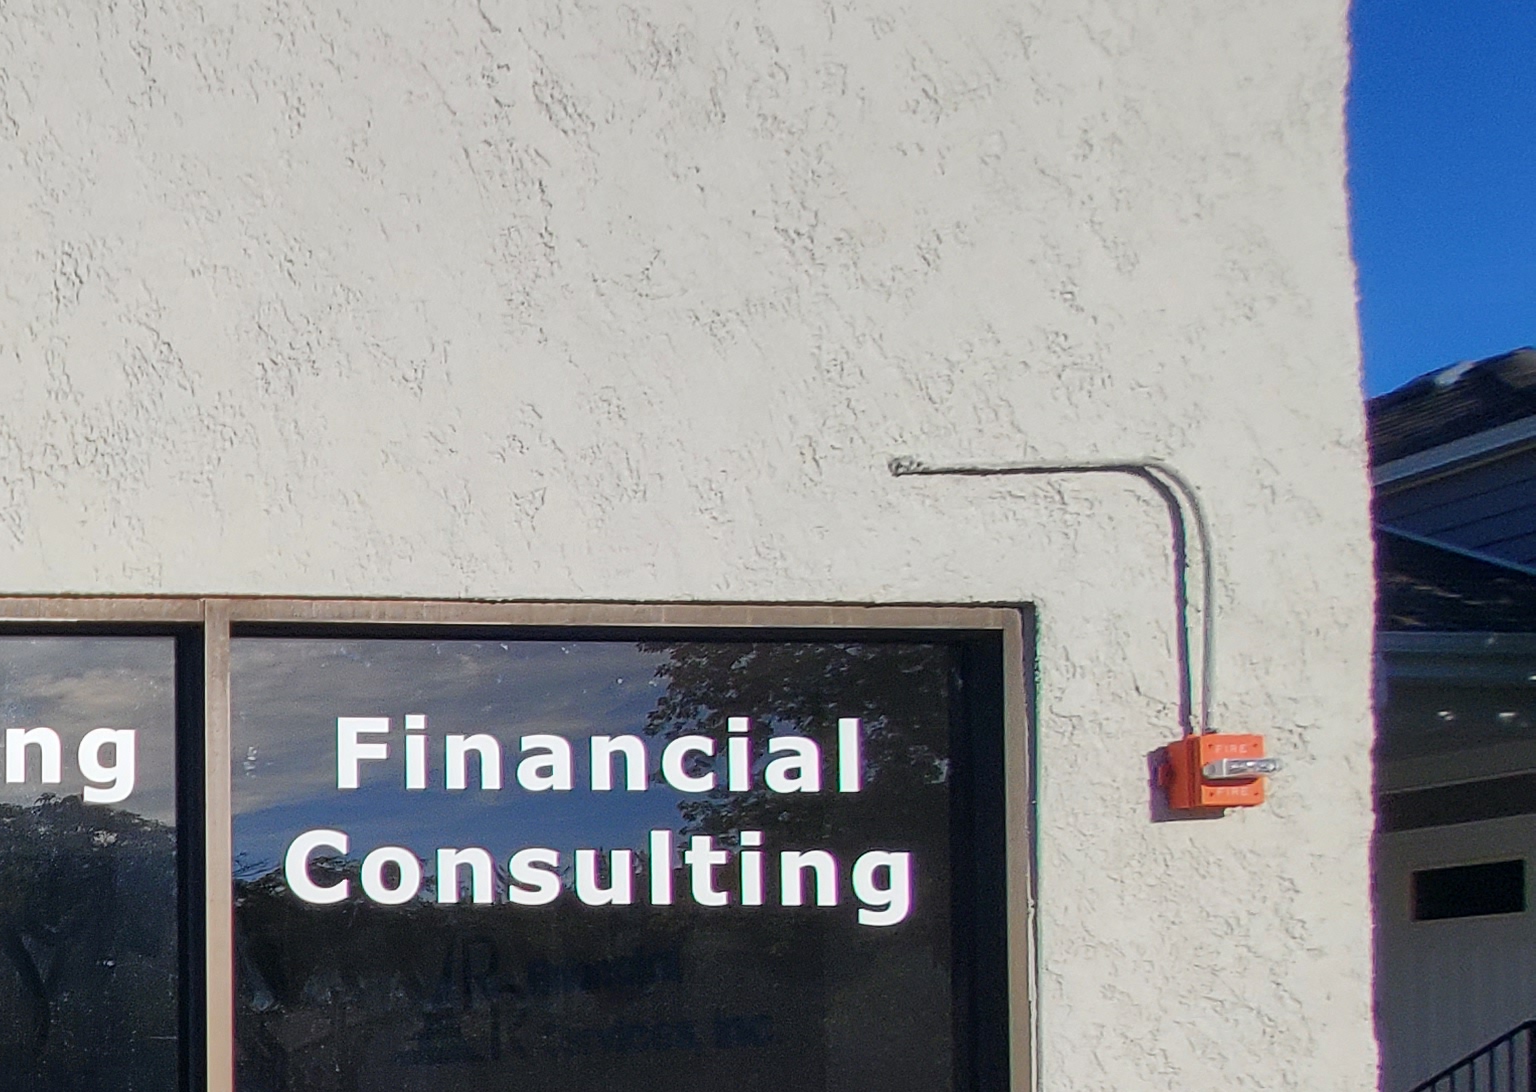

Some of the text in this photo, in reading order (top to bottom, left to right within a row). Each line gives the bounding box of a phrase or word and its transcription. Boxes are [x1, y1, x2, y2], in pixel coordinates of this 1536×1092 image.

[335, 713, 862, 795] Financial
[1215, 744, 1248, 753] FIRE
[1216, 787, 1249, 796] FIRE
[284, 828, 912, 927] Consulting
